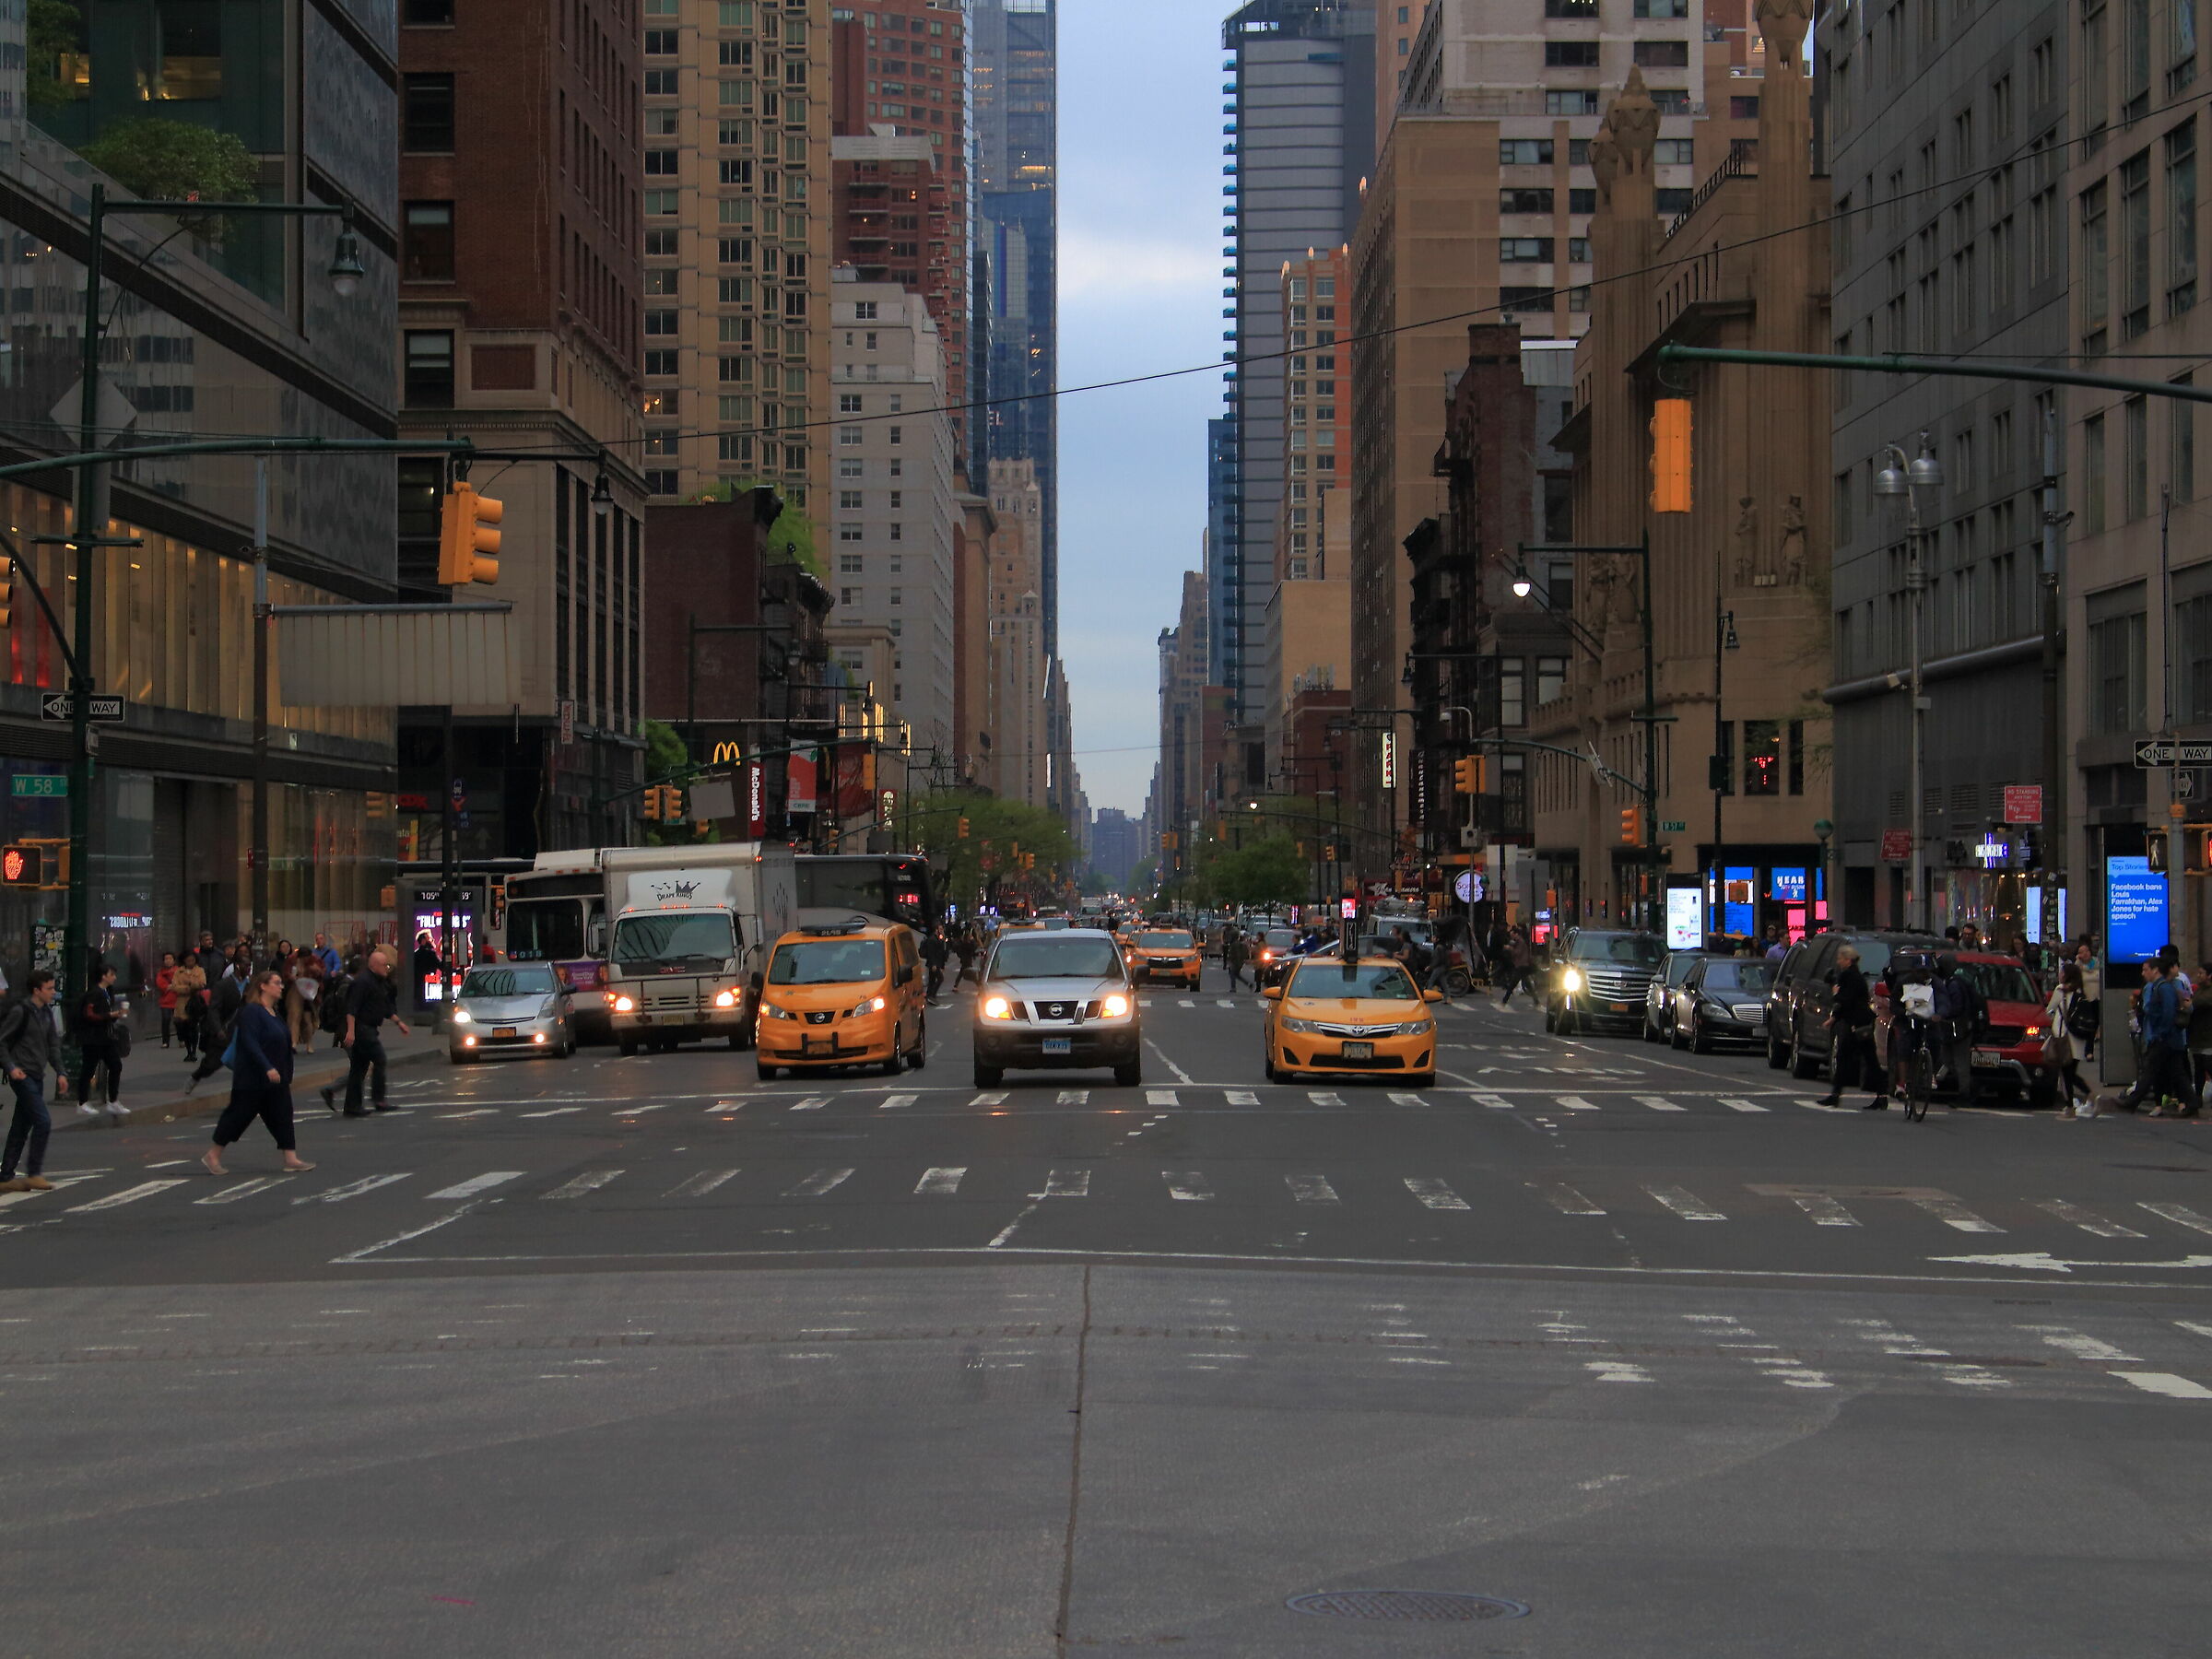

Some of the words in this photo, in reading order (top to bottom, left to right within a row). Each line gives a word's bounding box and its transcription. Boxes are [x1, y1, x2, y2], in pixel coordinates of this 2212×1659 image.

[91, 702, 116, 713] WAY
[2144, 748, 2170, 759] ONE
[2183, 748, 2208, 759] WAY
[15, 779, 27, 794] W
[34, 779, 53, 794] 58
[751, 767, 760, 821] McDonald's
[2111, 912, 2136, 921] speech
